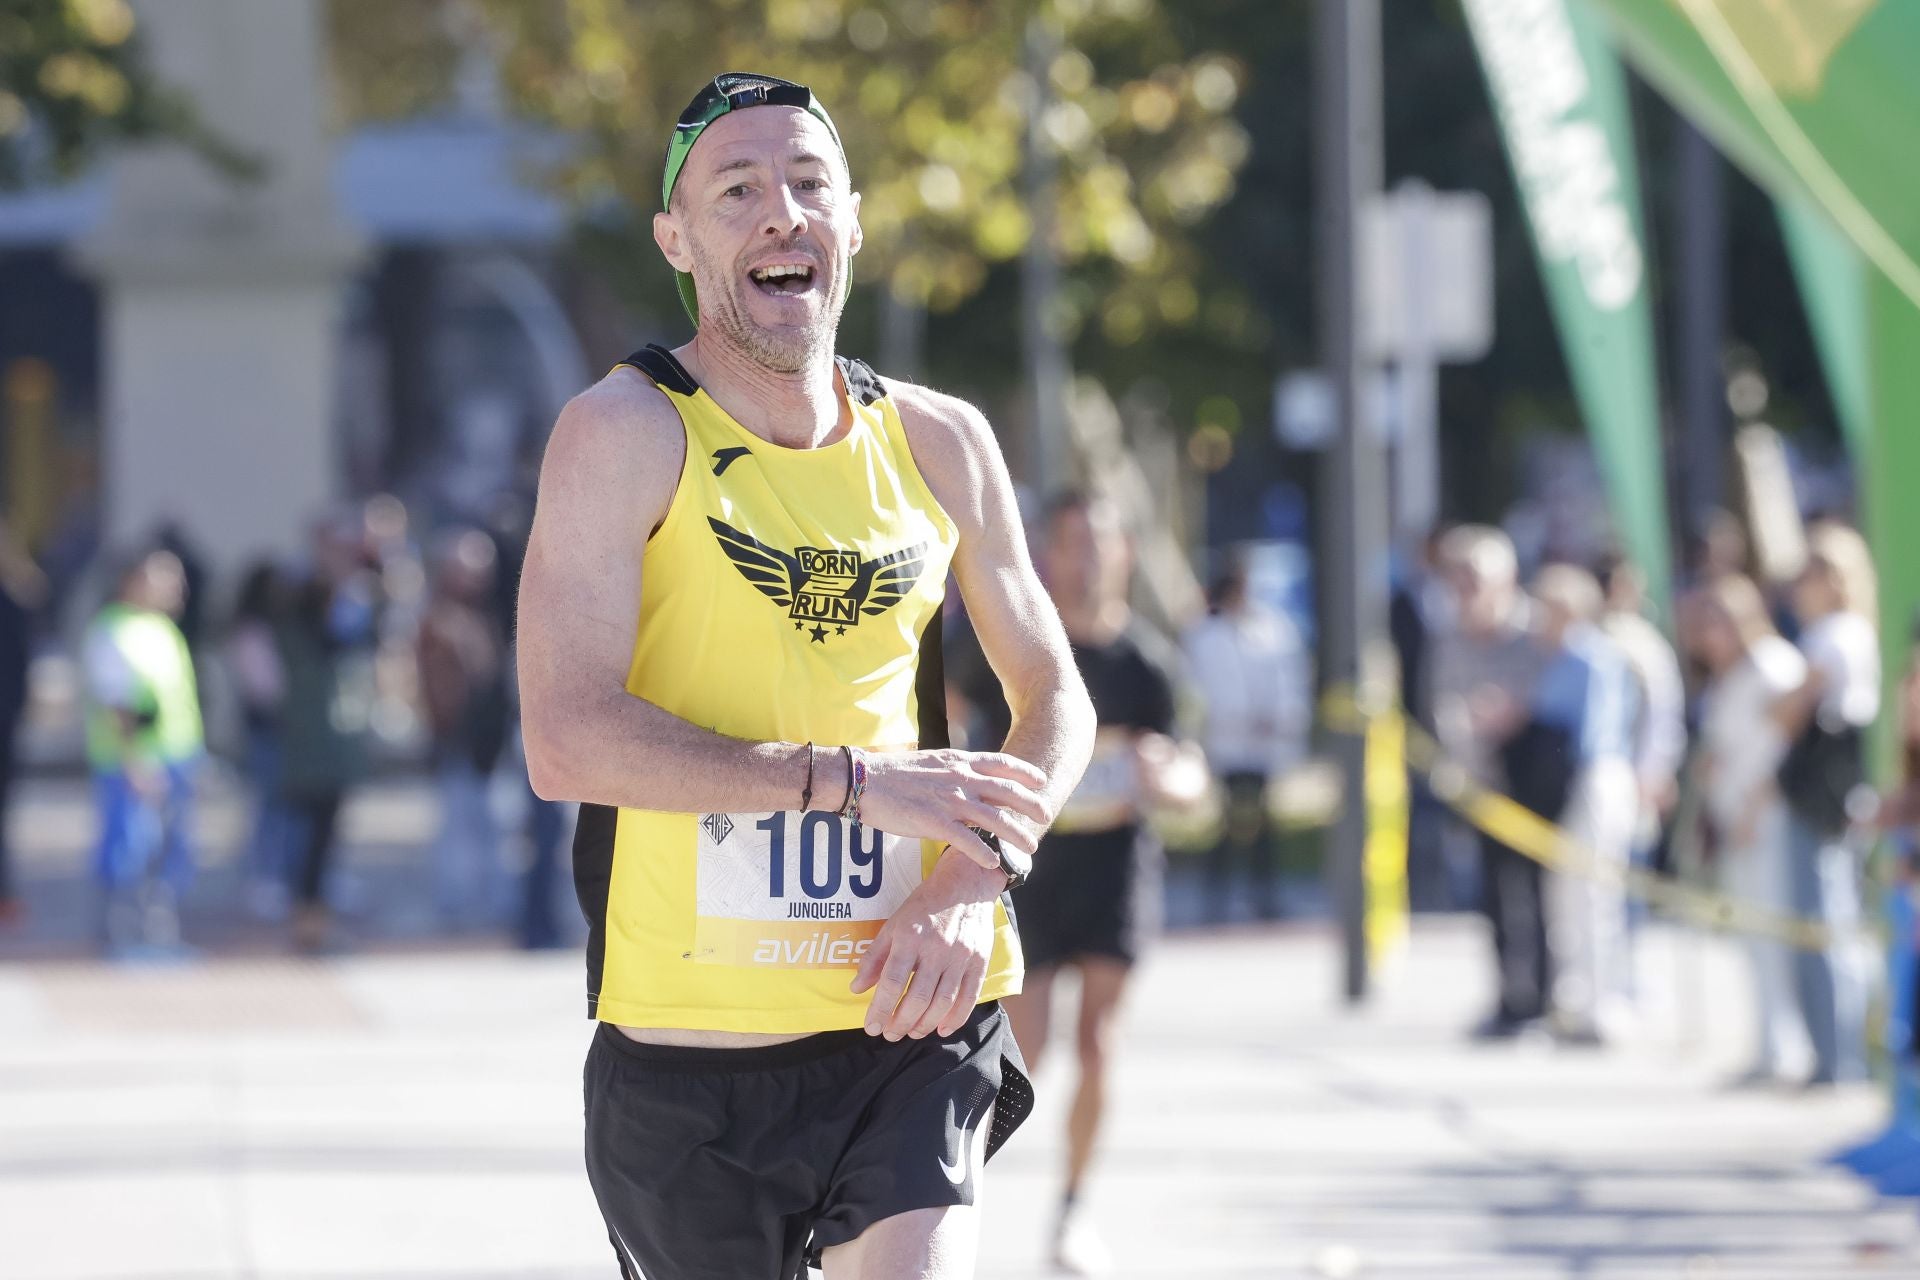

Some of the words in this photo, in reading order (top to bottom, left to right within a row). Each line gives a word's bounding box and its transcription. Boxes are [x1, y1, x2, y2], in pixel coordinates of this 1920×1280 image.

[801, 551, 856, 576] BORN
[794, 594, 855, 620] RUN
[756, 810, 883, 899] 109
[787, 902, 851, 919] JUNQUERA
